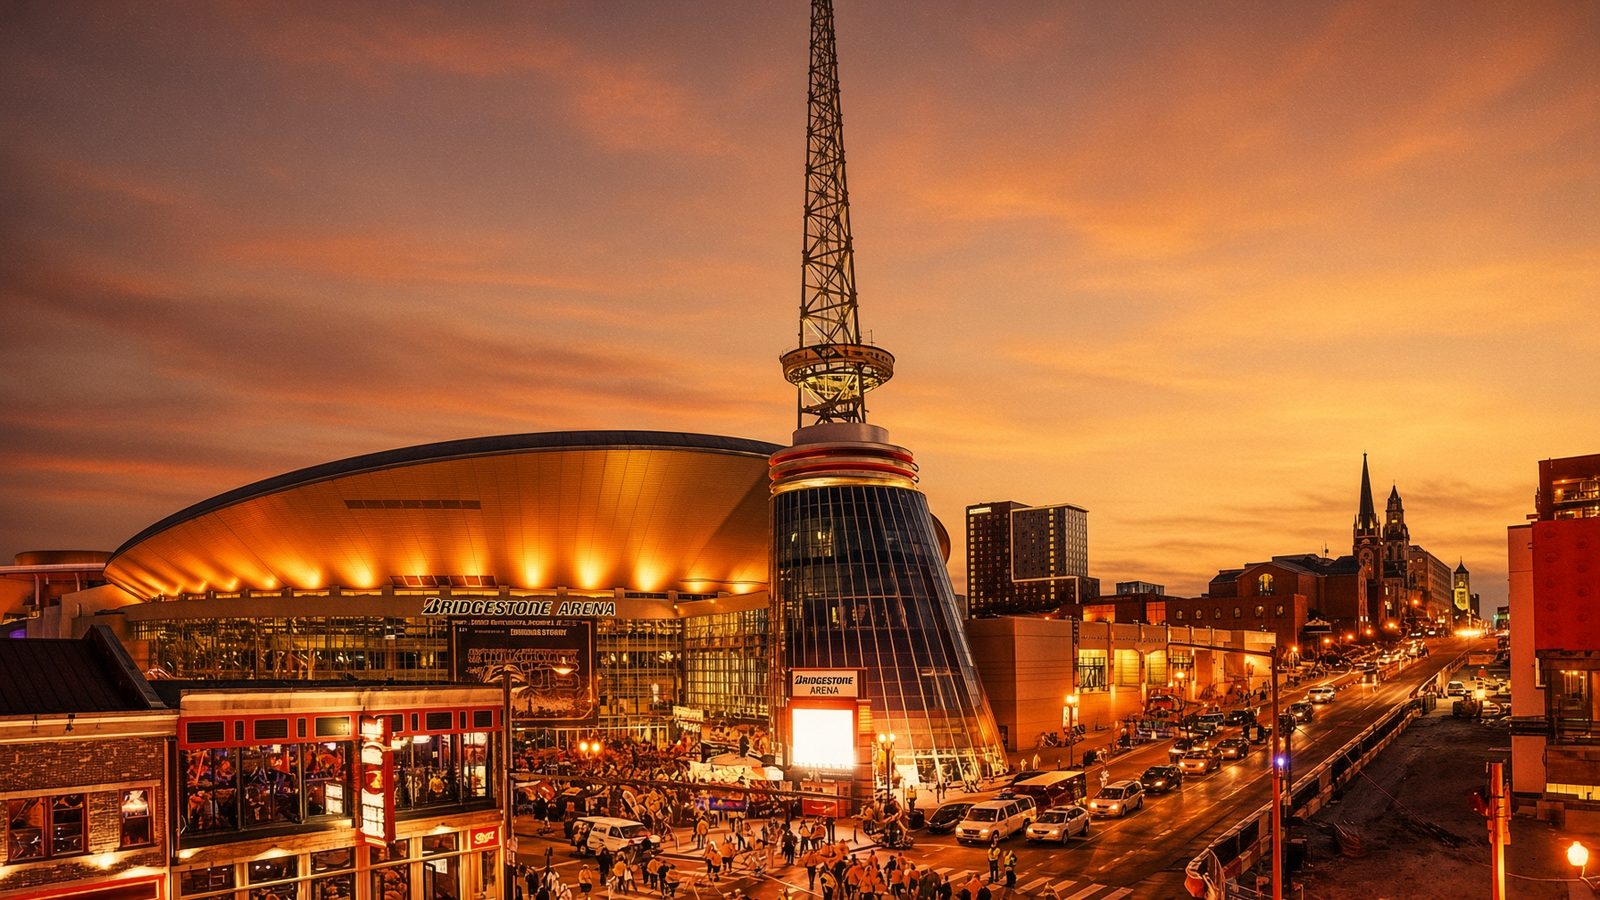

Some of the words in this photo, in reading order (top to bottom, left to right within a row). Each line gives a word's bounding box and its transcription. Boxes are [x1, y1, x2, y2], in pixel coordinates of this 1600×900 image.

[422, 598, 553, 616] BRIDGESTONE
[556, 601, 616, 616] ARENA
[795, 675, 854, 685] BRIDGESTONE
[810, 686, 839, 695] ARENA
